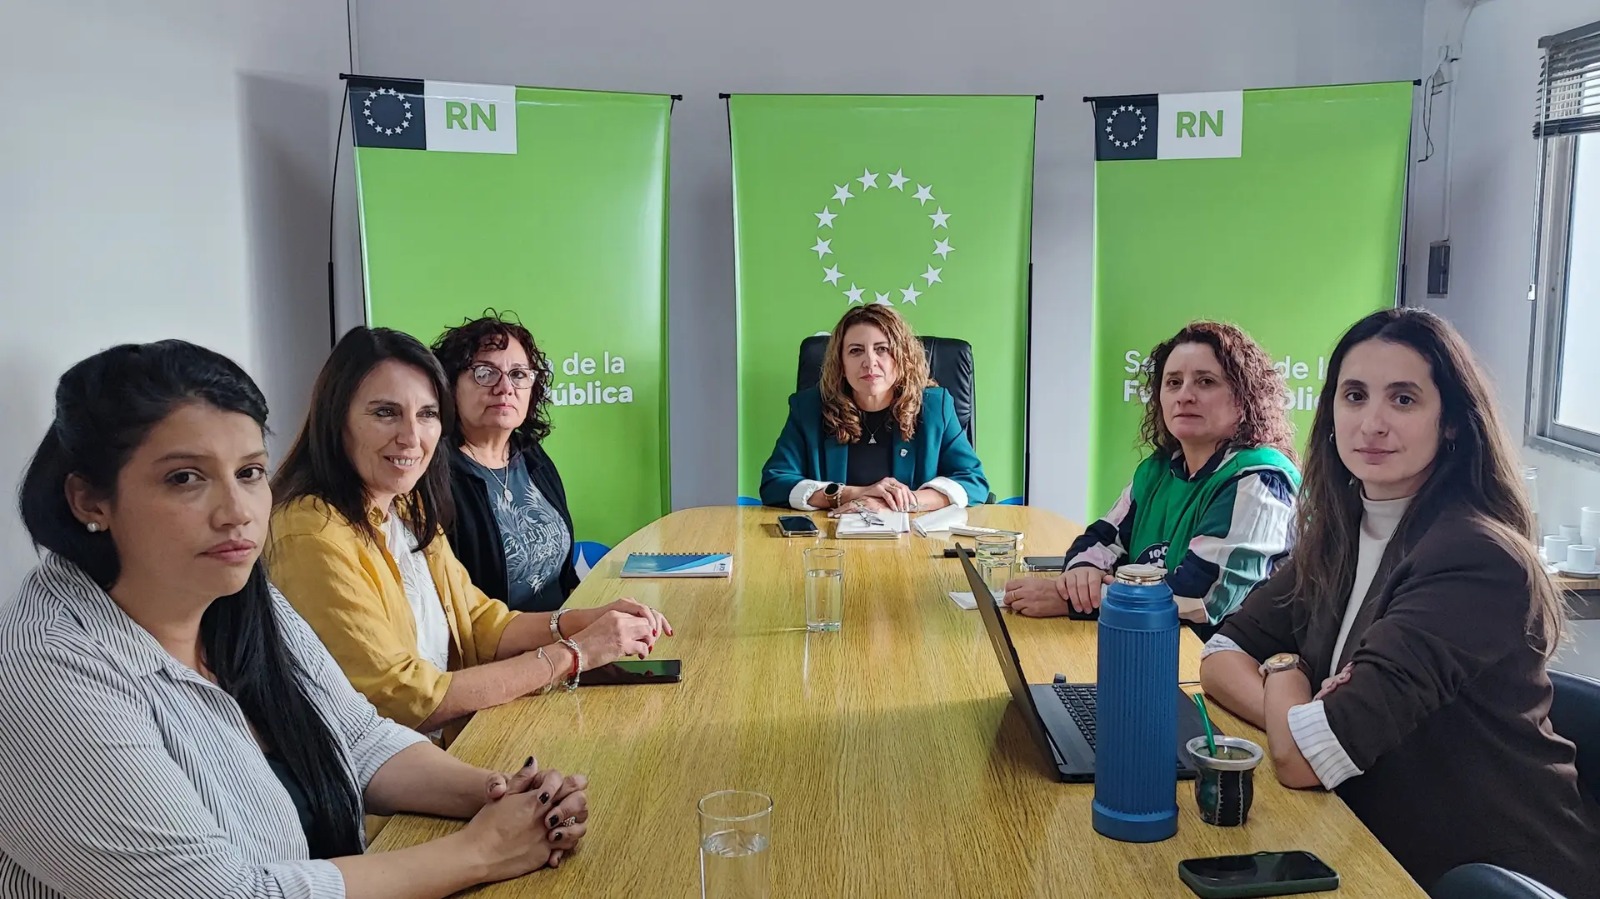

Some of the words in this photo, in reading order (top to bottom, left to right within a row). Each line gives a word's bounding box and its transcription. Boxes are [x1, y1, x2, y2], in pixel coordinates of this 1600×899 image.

[446, 102, 497, 132] RN
[1176, 110, 1224, 138] RN
[562, 352, 597, 376] de
[604, 351, 625, 374] la
[1273, 356, 1309, 380] de
